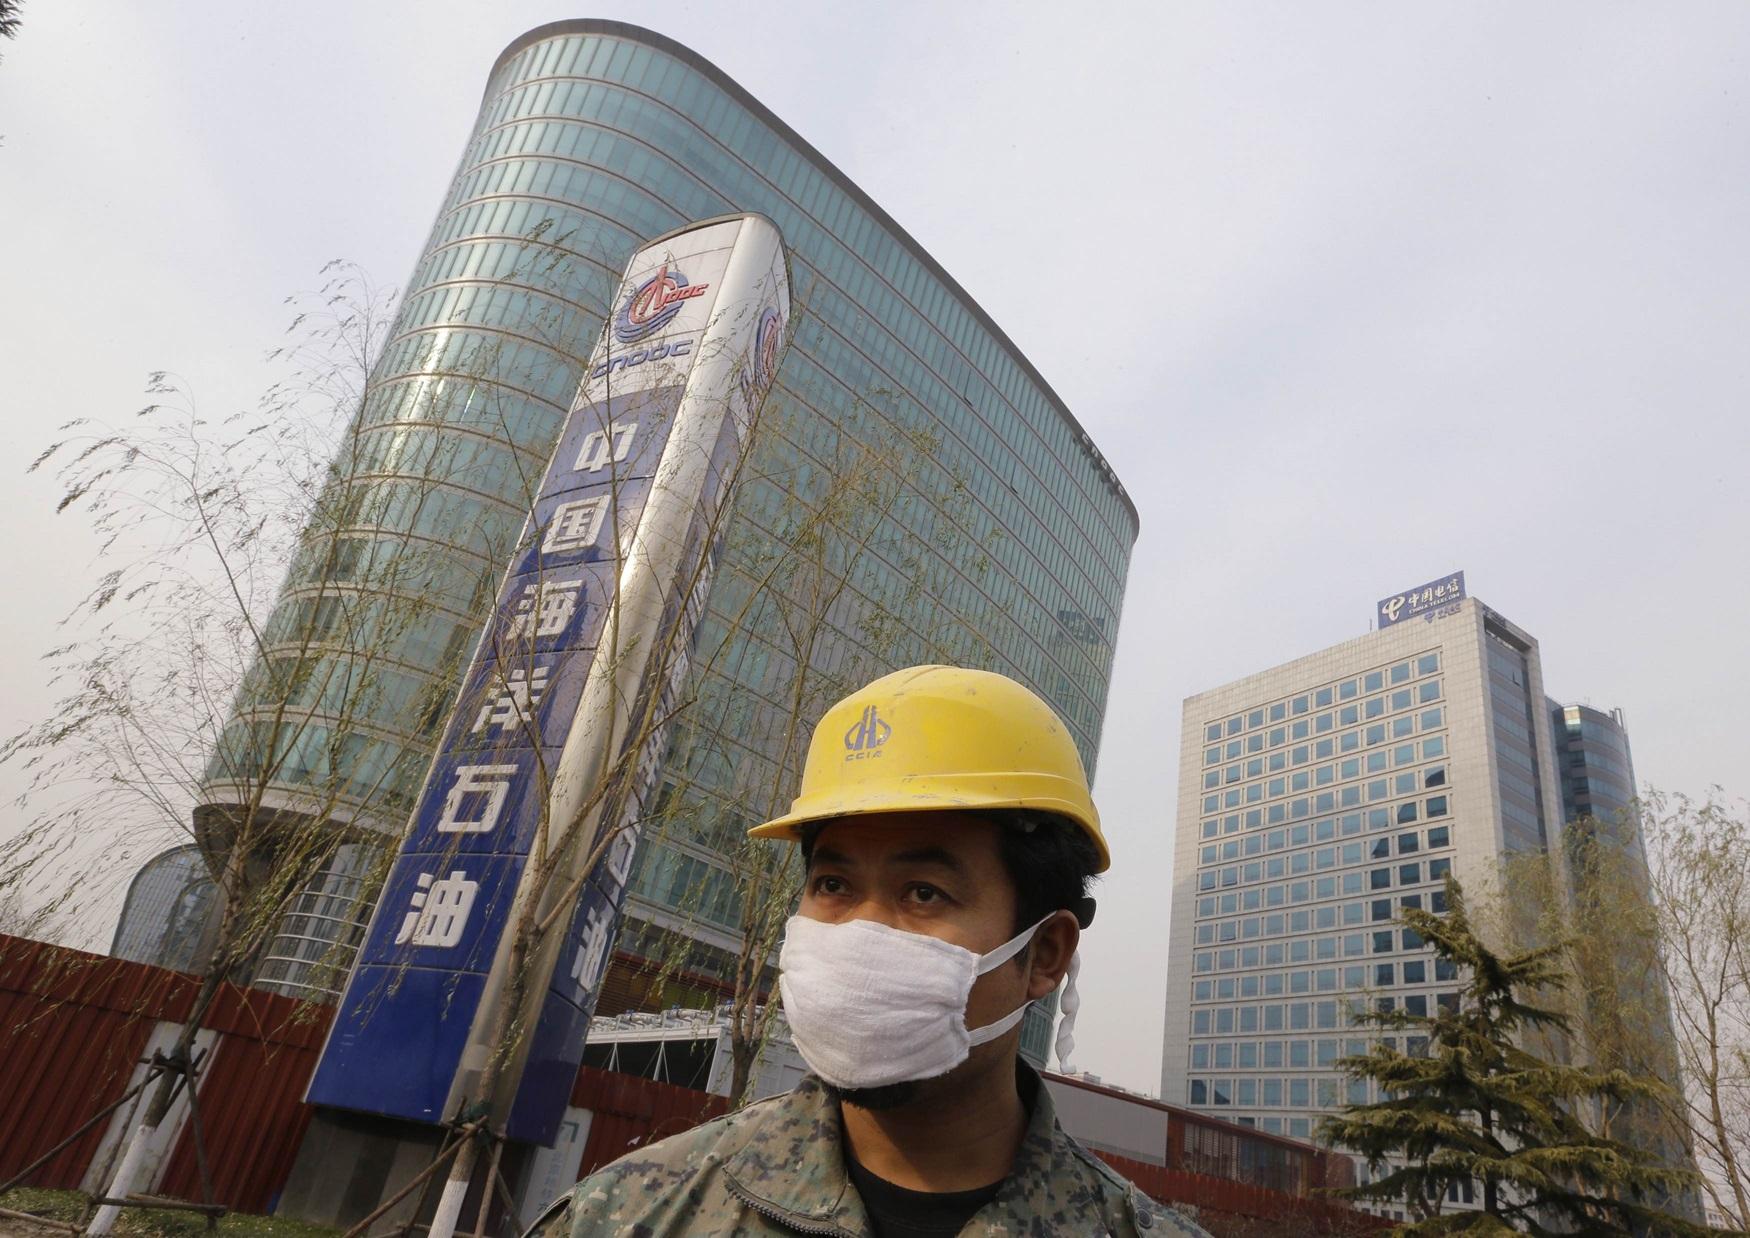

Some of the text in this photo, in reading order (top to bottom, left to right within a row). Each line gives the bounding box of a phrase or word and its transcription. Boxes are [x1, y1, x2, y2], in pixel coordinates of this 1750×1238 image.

[394, 421, 638, 948] 中国海洋石油
[1408, 578, 1460, 608] 中国电信
